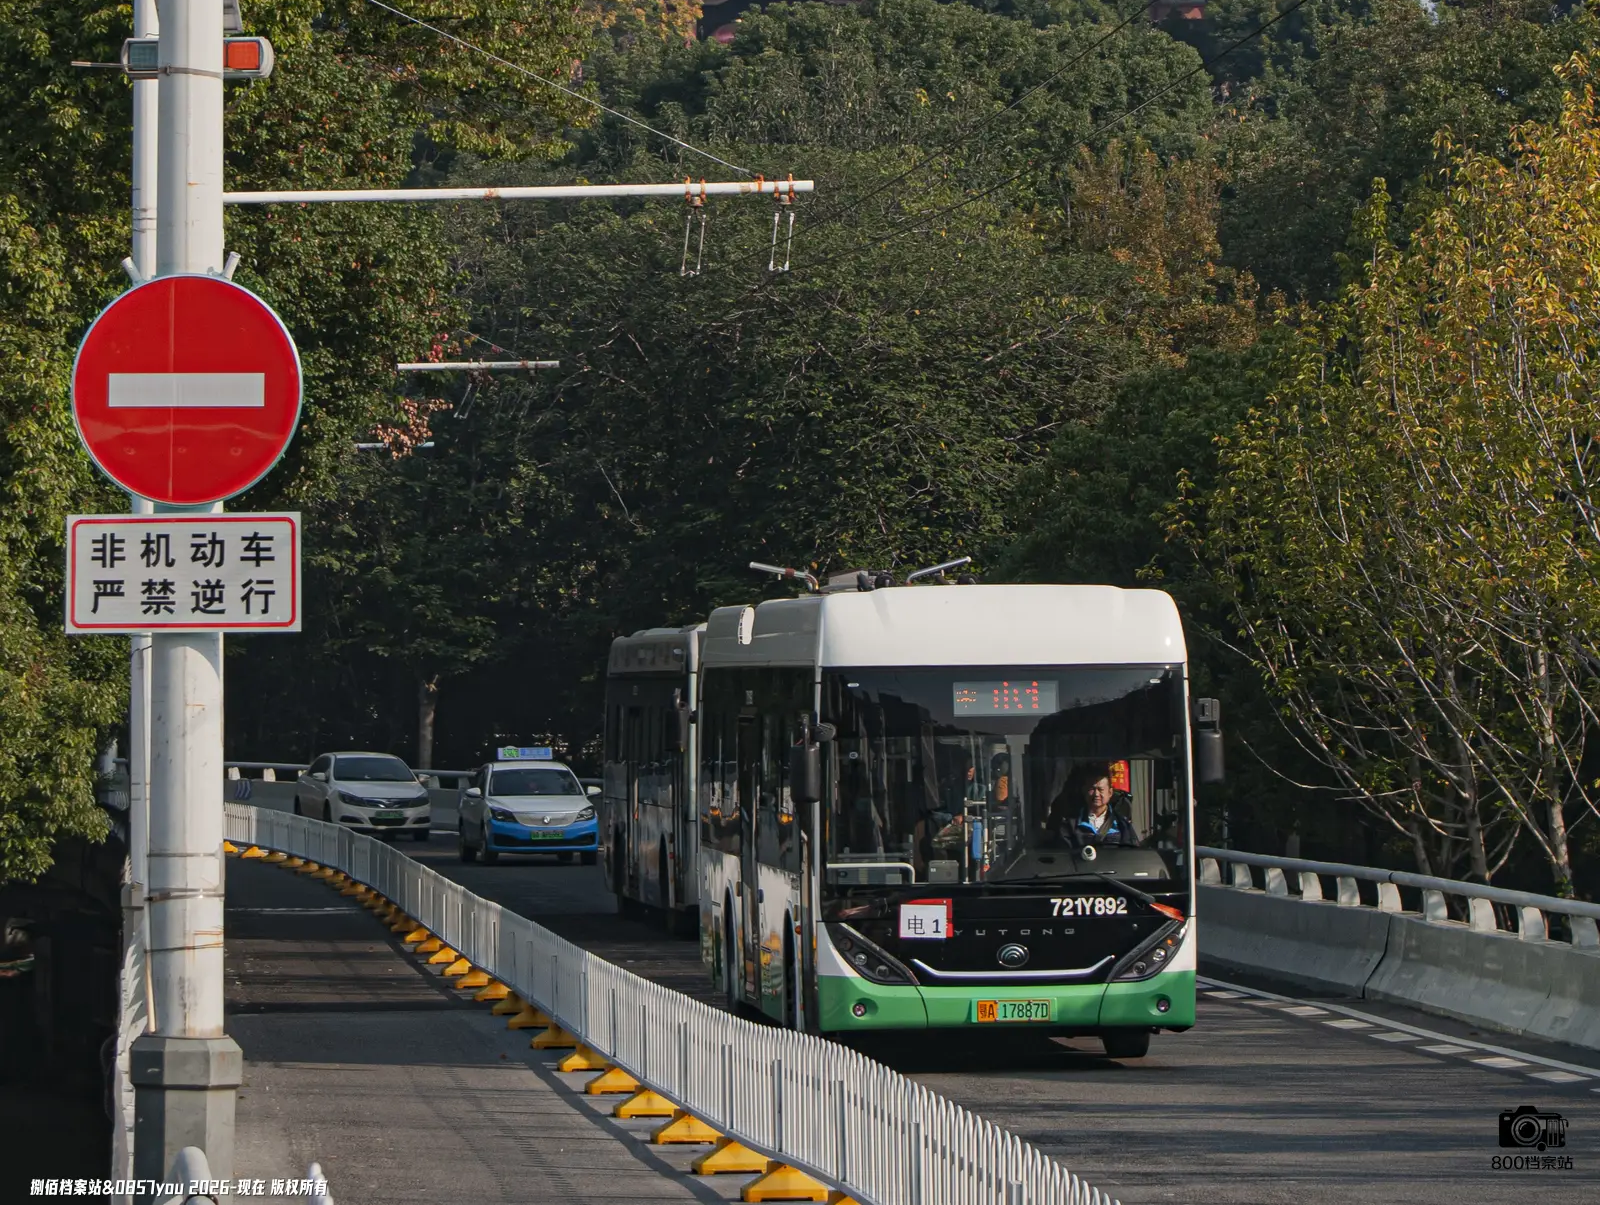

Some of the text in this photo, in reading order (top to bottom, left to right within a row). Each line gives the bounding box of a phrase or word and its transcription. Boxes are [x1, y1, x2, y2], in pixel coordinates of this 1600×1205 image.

[91, 532, 275, 569] 非机动车
[91, 578, 276, 615] 严禁逆行
[1050, 897, 1128, 917] 721Y892
[907, 914, 942, 935] 电 1
[954, 928, 1076, 936] YUTONG
